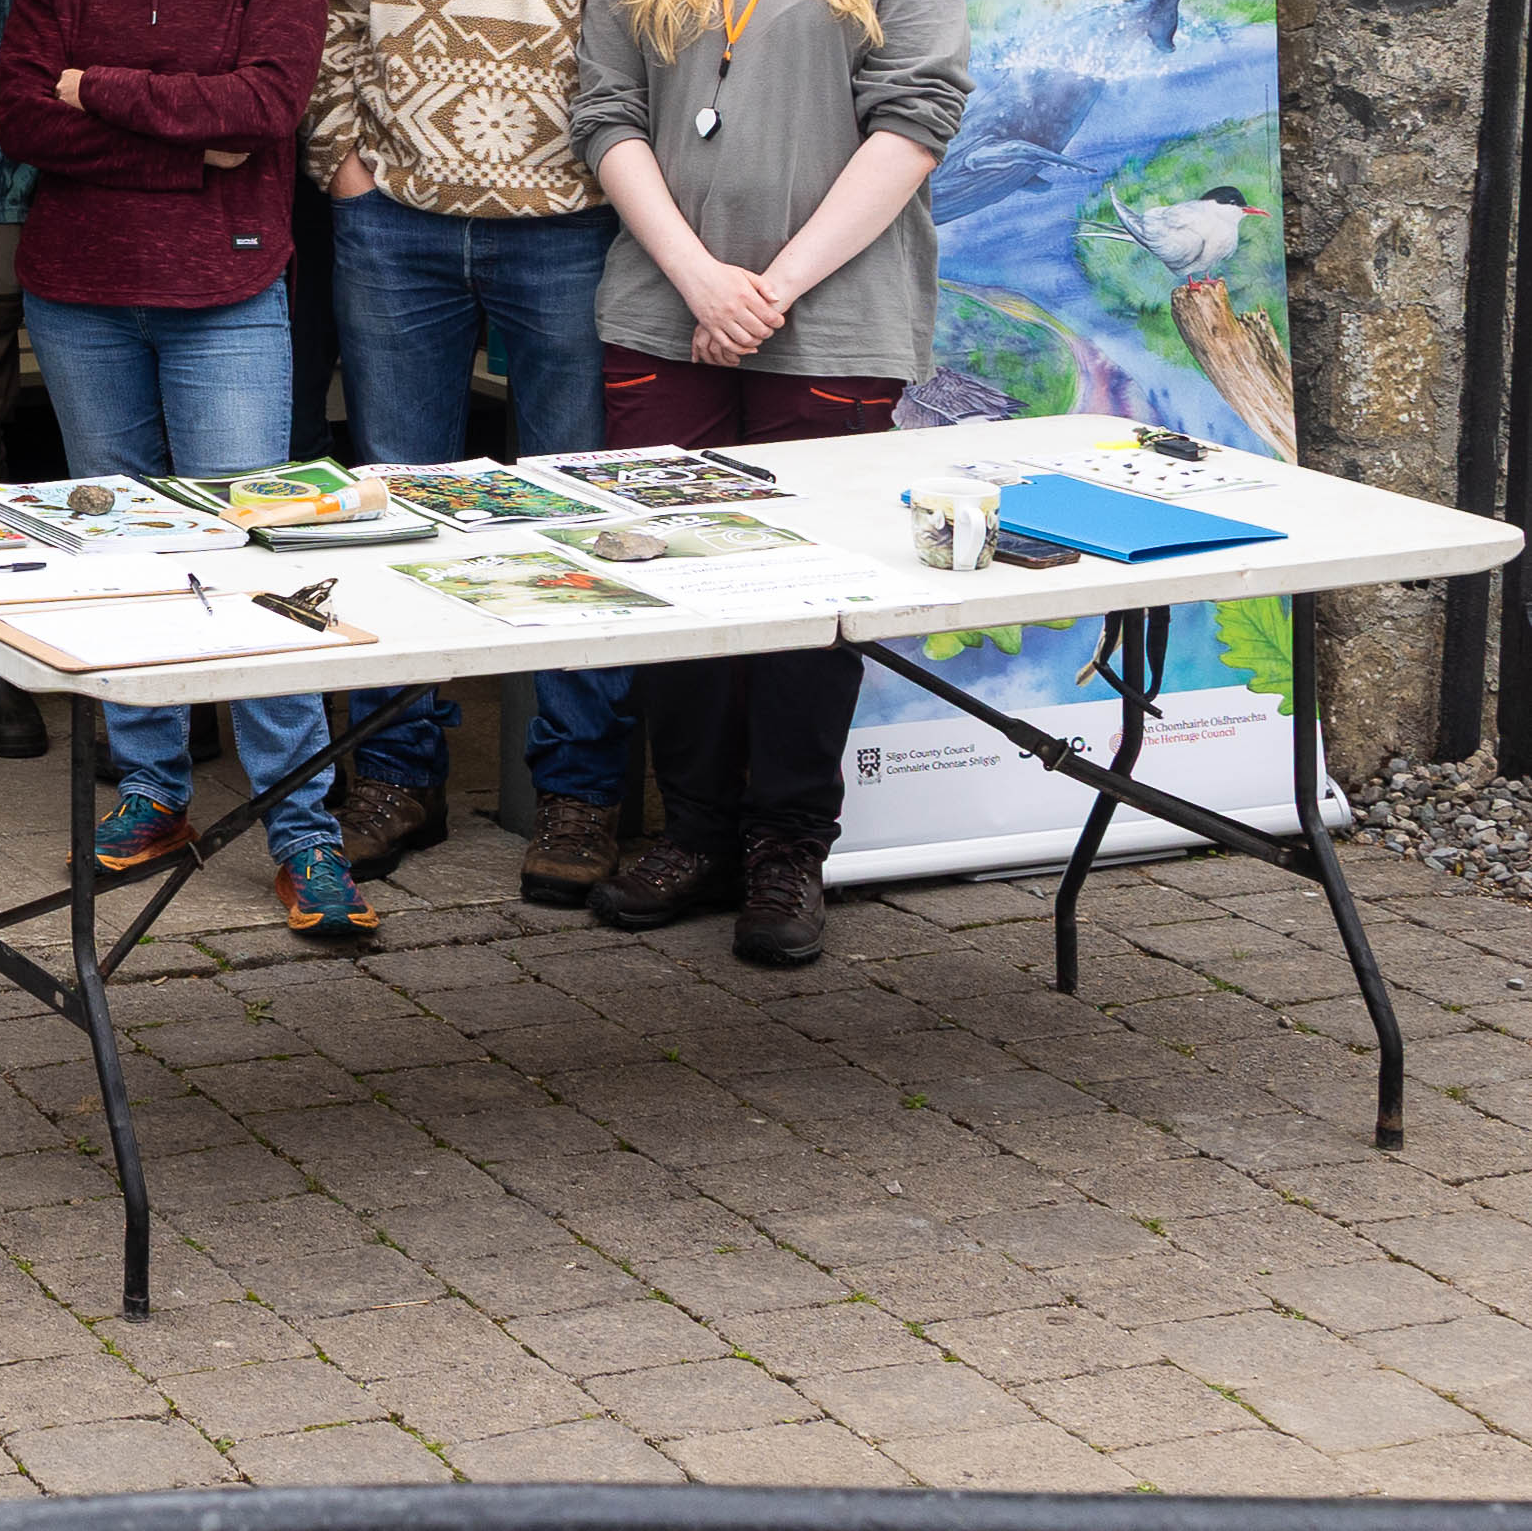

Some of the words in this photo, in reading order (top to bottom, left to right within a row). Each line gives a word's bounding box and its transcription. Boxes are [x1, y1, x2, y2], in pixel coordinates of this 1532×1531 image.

[1160, 732, 1200, 744] Heritage
[1201, 726, 1236, 739] Council
[885, 751, 908, 763] Sligo
[909, 747, 943, 760] County
[944, 743, 975, 755] Council
[886, 762, 930, 775] Comhairle
[932, 759, 967, 771] Chontae
